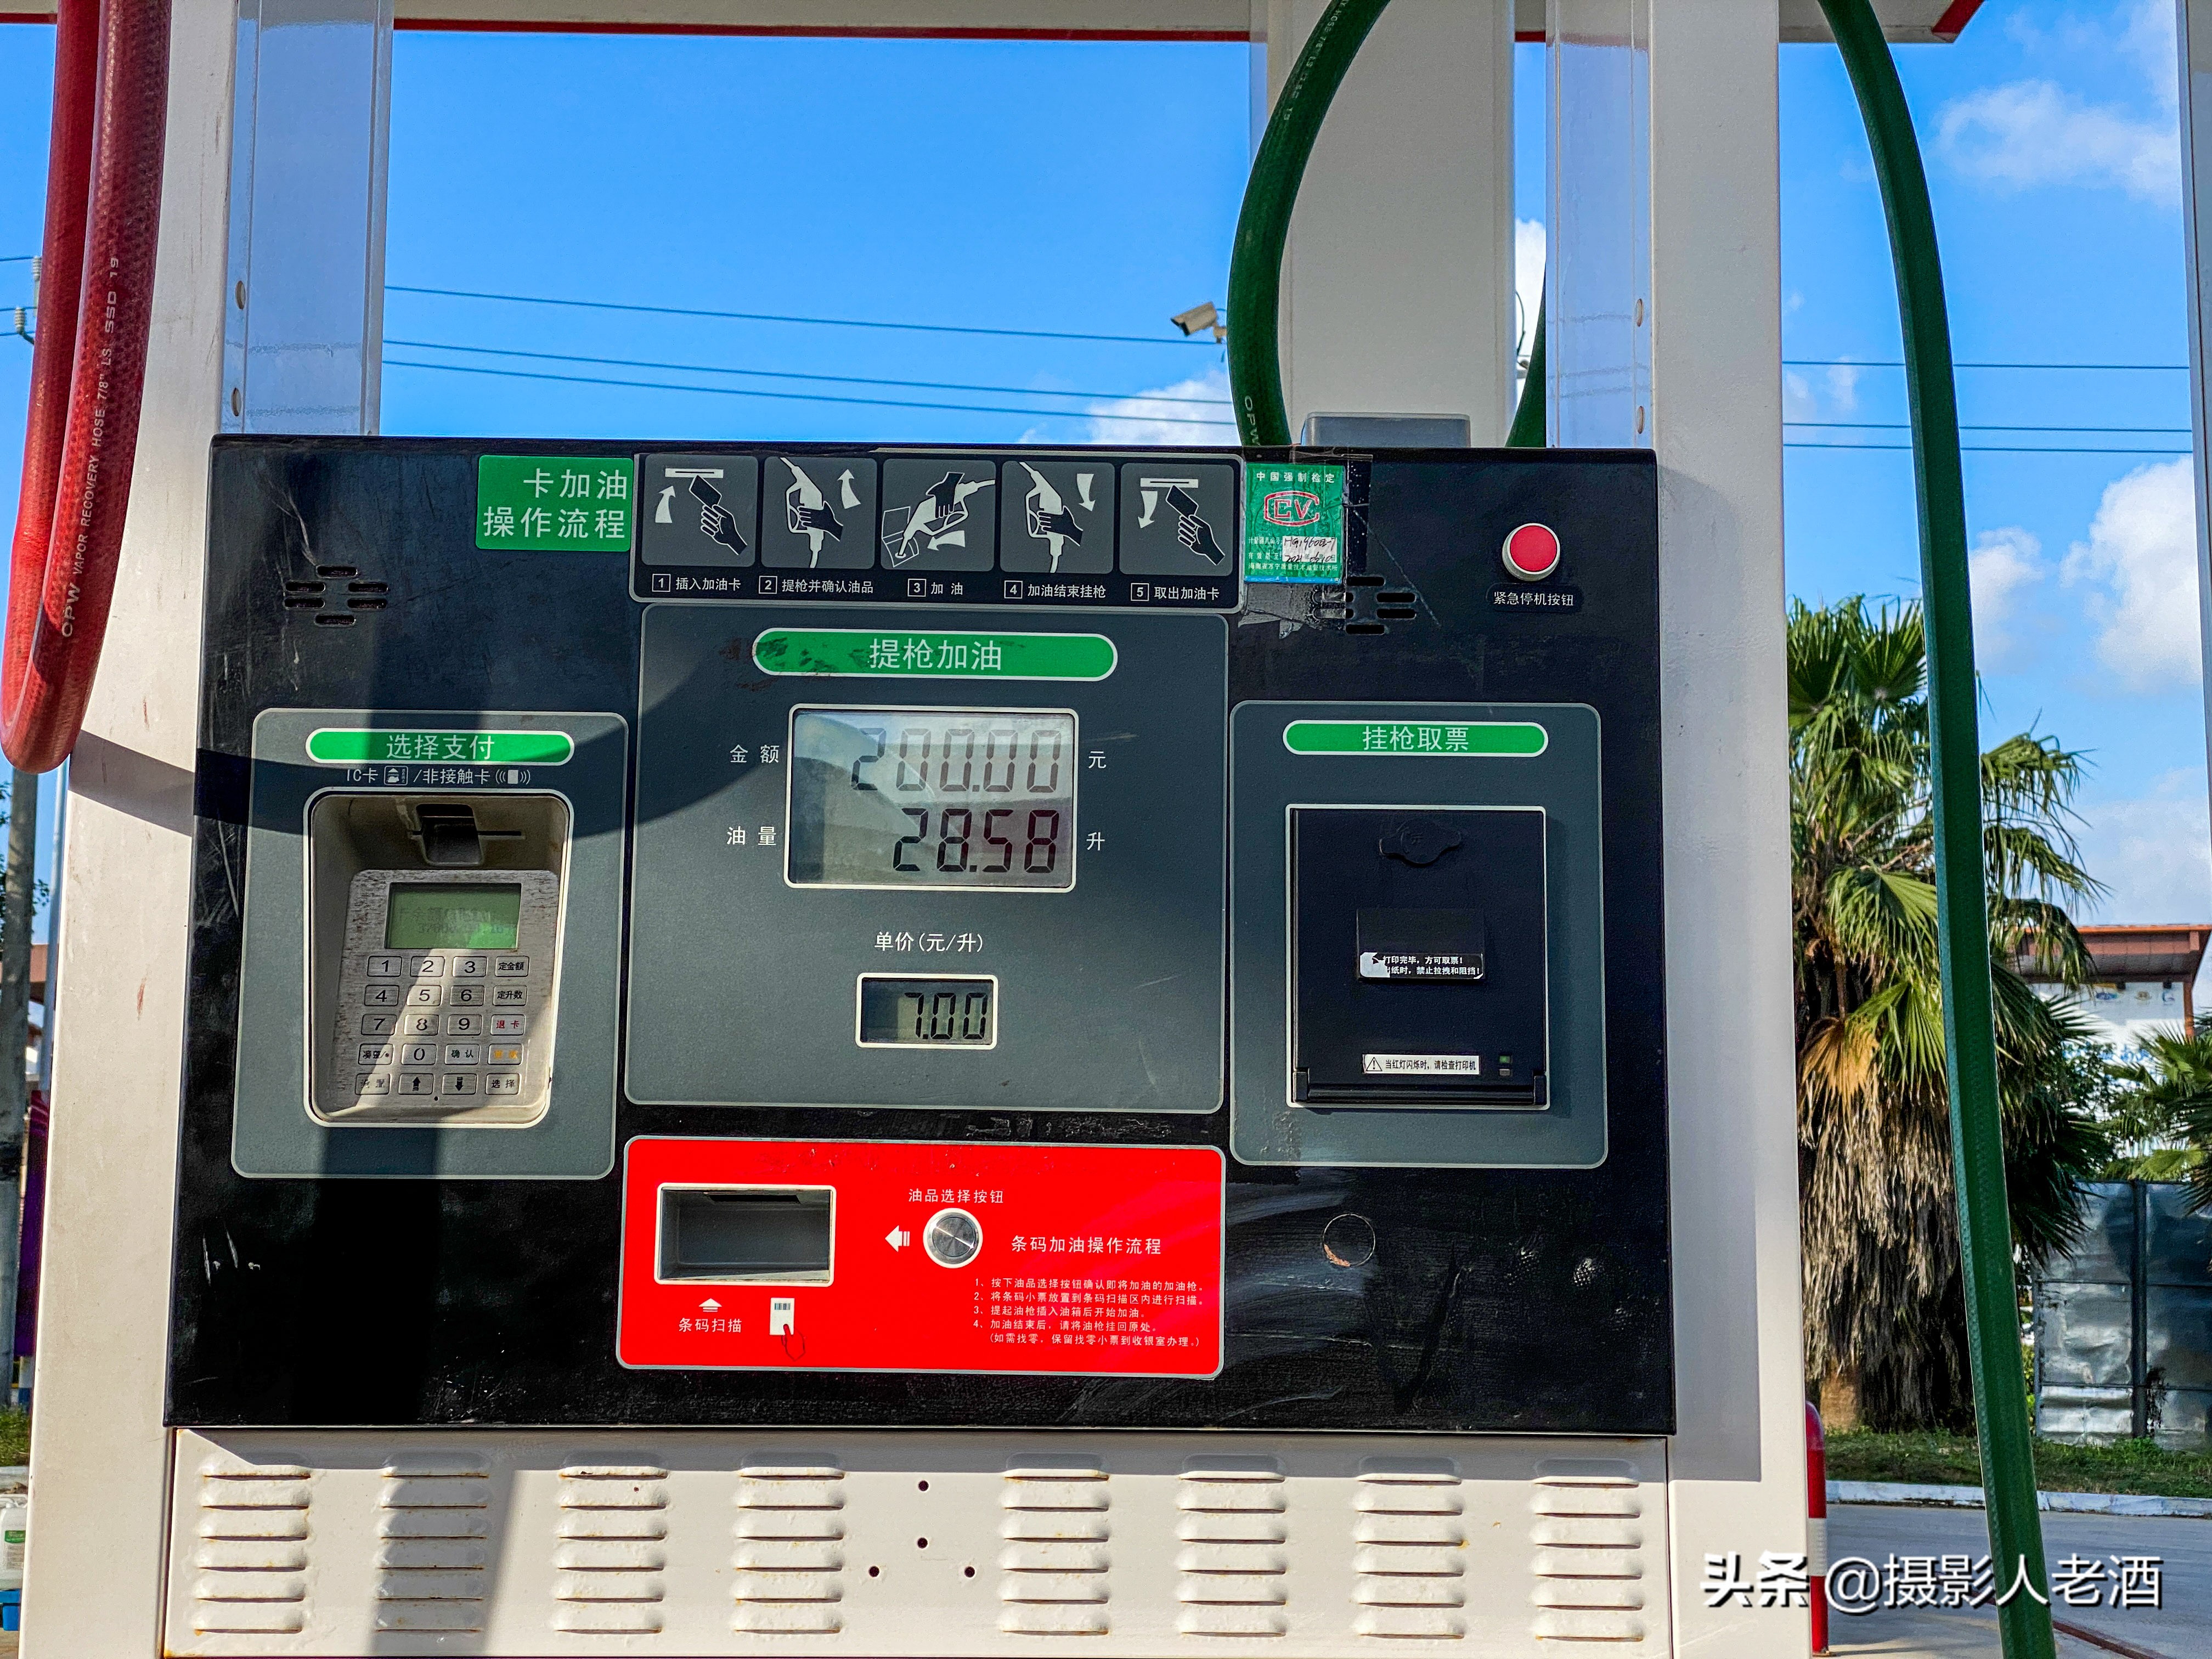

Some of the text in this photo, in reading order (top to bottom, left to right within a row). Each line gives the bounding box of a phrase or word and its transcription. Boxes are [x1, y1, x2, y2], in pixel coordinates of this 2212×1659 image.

[110, 257, 119, 278] 19
[105, 291, 117, 334] SSD
[101, 348, 112, 365] LS
[92, 409, 105, 448] HOSE
[523, 468, 628, 500] 卡加油
[1257, 471, 1335, 483] 中国强制检定
[81, 455, 100, 527] RECOVERY
[483, 507, 625, 539] 操作流程
[73, 535, 88, 575] VAPOR
[658, 578, 741, 590] 1 插入加油卡
[764, 579, 873, 594] 2 提枪并确认油品
[913, 582, 963, 596] 3 加油
[1009, 584, 1106, 599] 4 加油结束挂枪
[1136, 587, 1220, 600] 5 取出加油卡
[1494, 591, 1573, 606] 紧急停机按钮
[61, 583, 80, 637] OPW
[870, 639, 1002, 671] 提枪加油
[387, 733, 495, 760] 选择支付
[1363, 726, 1469, 752] 挂枪取票
[730, 744, 779, 763] 金额
[851, 727, 1062, 793] 200.00
[1088, 752, 1107, 769] 元
[347, 769, 378, 783] IC卡
[413, 770, 490, 785] /非接触卡
[727, 826, 777, 847] 油量
[893, 808, 1059, 873] 28.58
[1086, 832, 1105, 851] 升
[874, 932, 984, 952] 单价(元/升)
[381, 961, 390, 972] 1
[422, 960, 434, 972] 2
[464, 961, 476, 973] 3
[498, 962, 524, 971] 定金额
[375, 990, 387, 1002] 4
[419, 989, 430, 1002] 5
[460, 989, 472, 1001] 6
[496, 991, 522, 1000] 定升数
[904, 992, 988, 1040] 7.00
[373, 1019, 386, 1030] 7
[416, 1019, 428, 1031] 8
[458, 1018, 470, 1030] 9
[496, 1020, 520, 1029] 退卡
[414, 1048, 425, 1060] 0
[451, 1049, 474, 1058] 确认
[1385, 1059, 1476, 1070] 当红灯闪烁时，请检查打印机
[491, 1079, 516, 1088] 选择
[908, 1189, 1004, 1204] 油品选择按钮
[1011, 1235, 1161, 1255] 条码加油操作流程
[679, 1318, 742, 1333] 条码扫描
